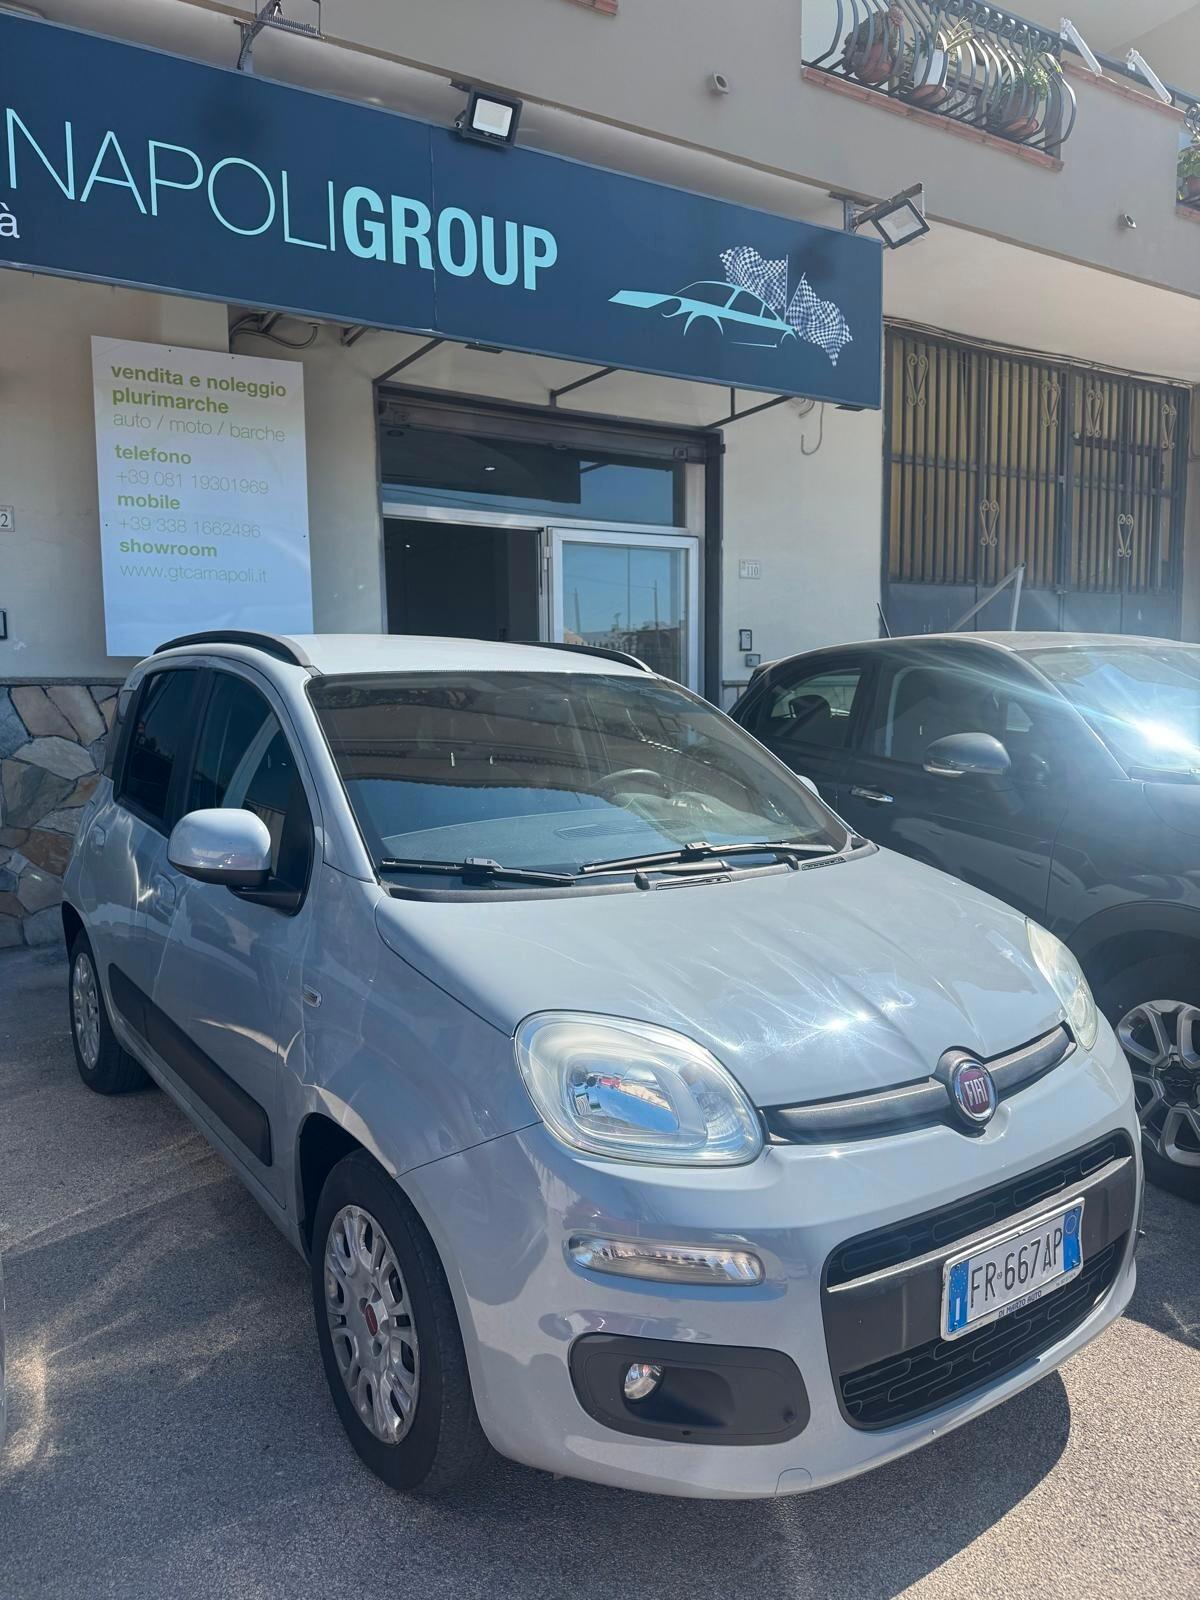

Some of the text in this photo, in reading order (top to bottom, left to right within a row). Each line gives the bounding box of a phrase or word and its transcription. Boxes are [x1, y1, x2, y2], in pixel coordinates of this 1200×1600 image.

[111, 366, 287, 398] vendita e noleggio
[112, 389, 229, 414] plurimarche
[113, 413, 286, 442] auto / moto / barche
[115, 444, 192, 465] telefono
[116, 468, 269, 495] +39 081 19301969
[117, 493, 181, 510] mobile
[119, 516, 262, 539] +39 338 1662496
[119, 539, 218, 558] showroom
[964, 1077, 988, 1106] FIAT
[970, 1261, 996, 1308] FR
